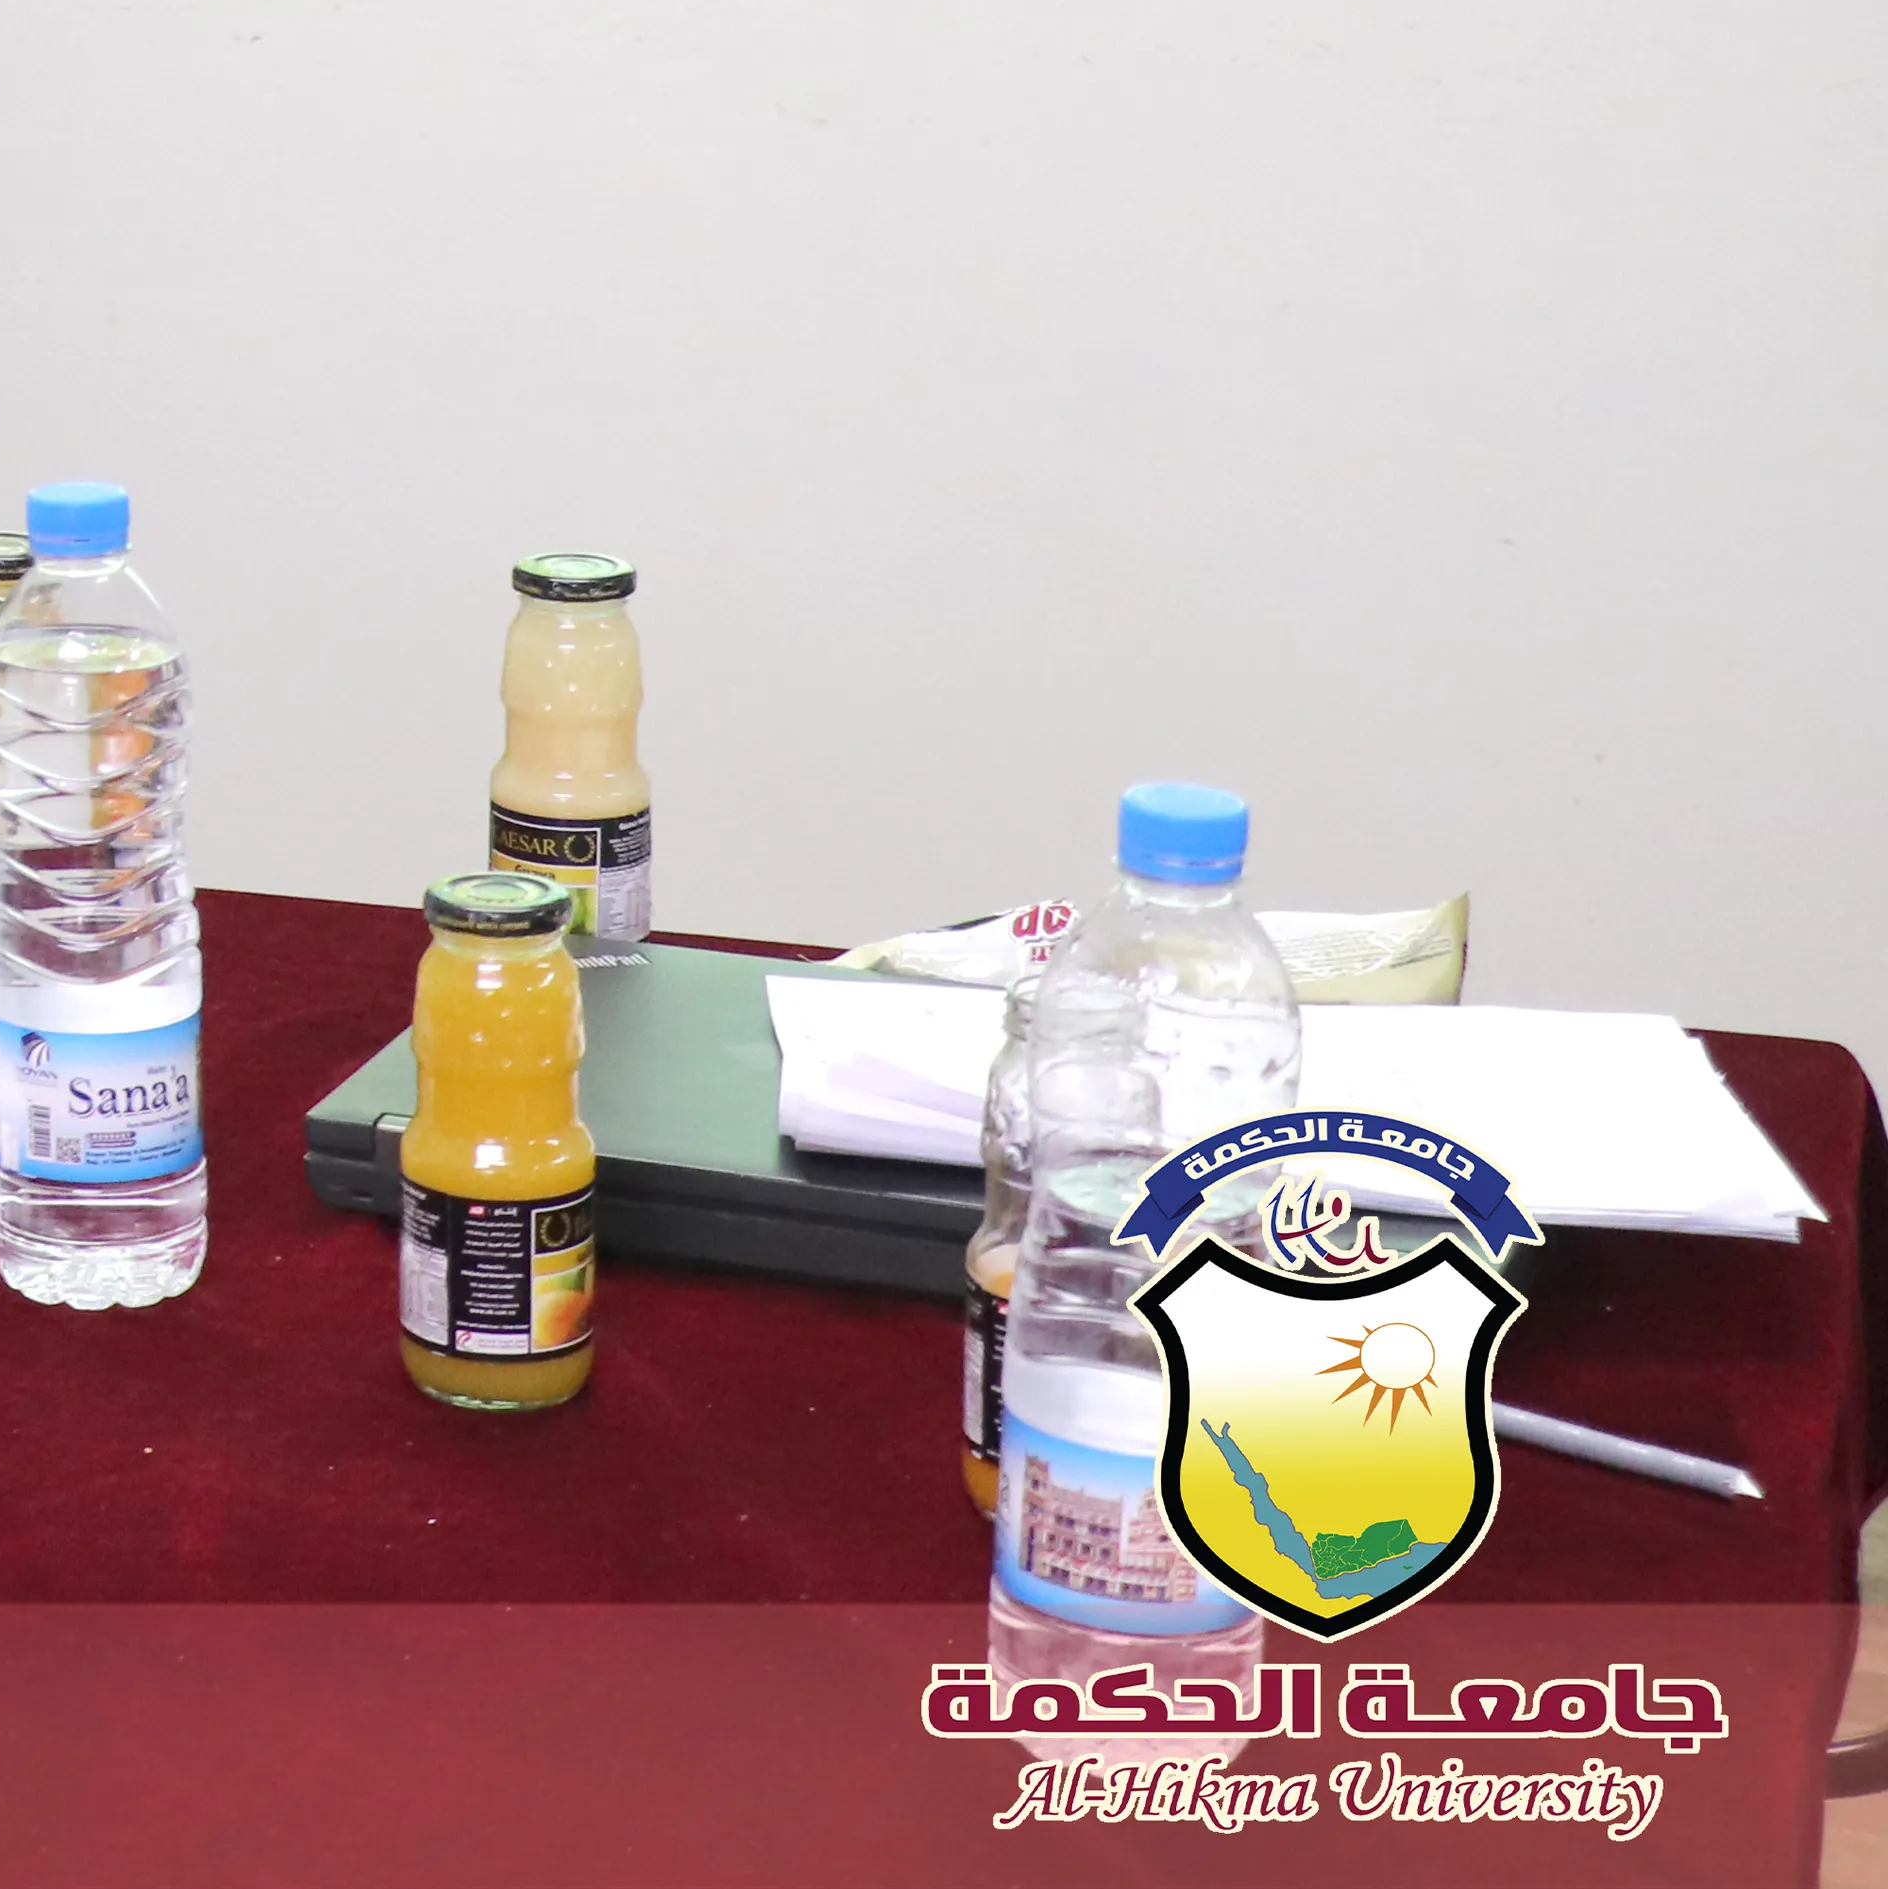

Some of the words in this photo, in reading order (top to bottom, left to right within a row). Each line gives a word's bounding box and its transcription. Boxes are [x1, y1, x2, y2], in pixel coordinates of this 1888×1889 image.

[497, 830, 559, 858] AESAR
[574, 952, 651, 969] inkPad
[68, 1065, 191, 1117] Sana'a
